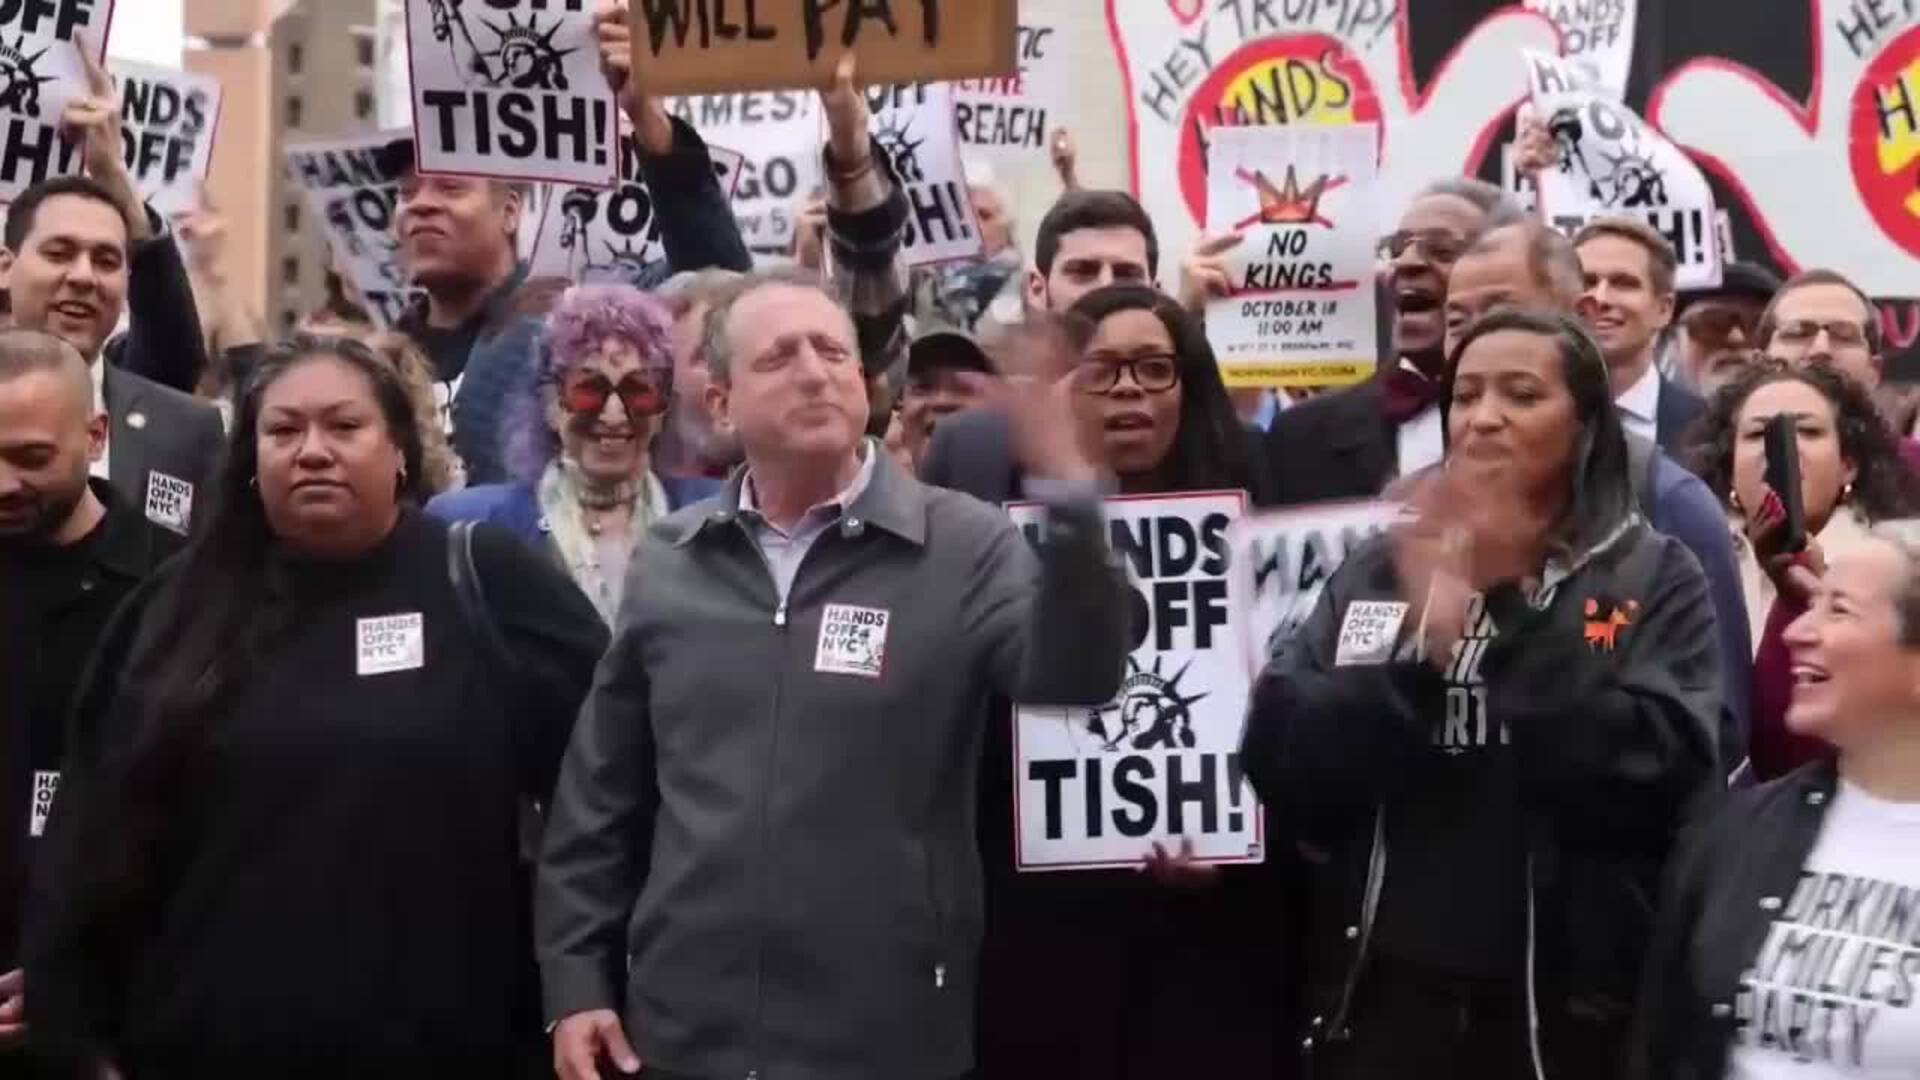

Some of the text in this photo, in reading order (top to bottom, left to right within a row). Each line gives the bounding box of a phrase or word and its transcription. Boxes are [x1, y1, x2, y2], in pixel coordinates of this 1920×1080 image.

[1837, 0, 1913, 57] HE
[1142, 21, 1212, 123] HEY
[121, 76, 206, 135] NDS
[423, 90, 607, 166] TISH!
[956, 102, 1046, 147] REACH
[1267, 229, 1307, 256] NO
[1243, 262, 1332, 289] KINGS
[1241, 301, 1317, 318] OCTOBER
[1296, 318, 1323, 335] AM
[152, 475, 190, 498] HANDS
[149, 498, 173, 515] NYC
[361, 618, 418, 634] HANDS
[828, 608, 885, 626] HANDS
[362, 644, 397, 658] NYC
[823, 636, 858, 654] NYC
[1028, 754, 1244, 840] TISH!
[1779, 869, 1920, 946] ORKIN
